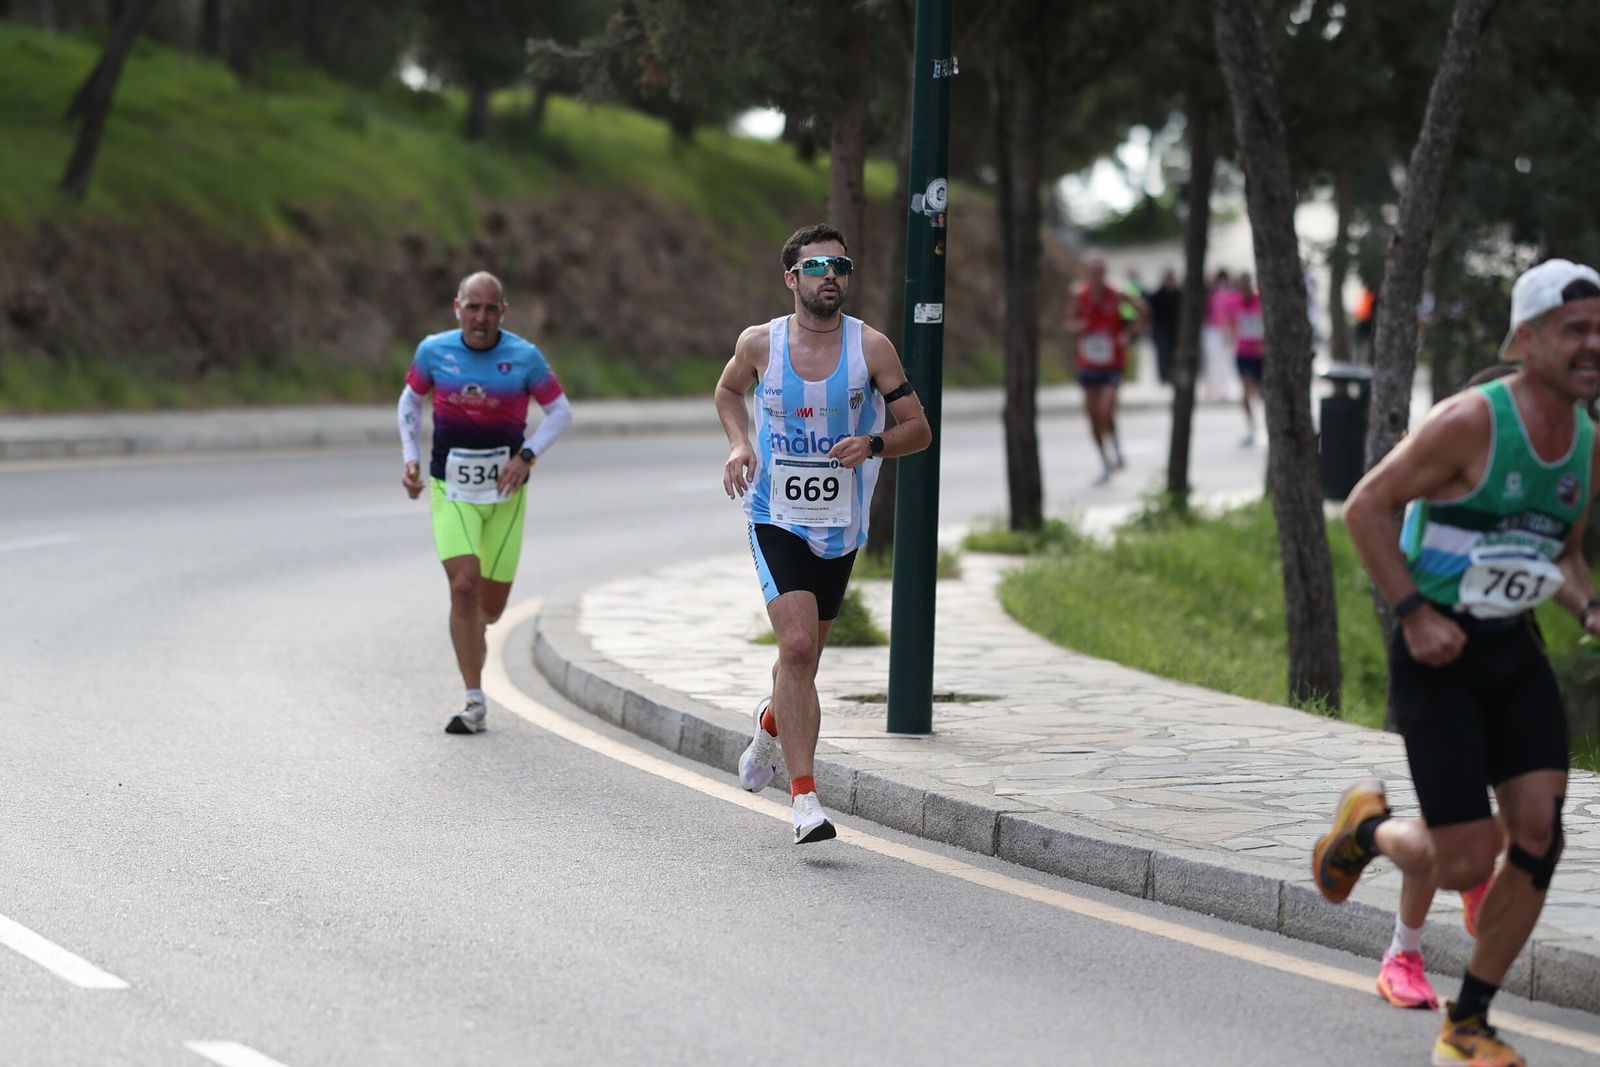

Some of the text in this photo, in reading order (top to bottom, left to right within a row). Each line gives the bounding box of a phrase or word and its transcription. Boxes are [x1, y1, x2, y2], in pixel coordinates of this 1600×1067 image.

[764, 387, 783, 396] vive
[457, 464, 500, 485] 534
[785, 476, 840, 502] 669
[1483, 568, 1547, 602] 761
